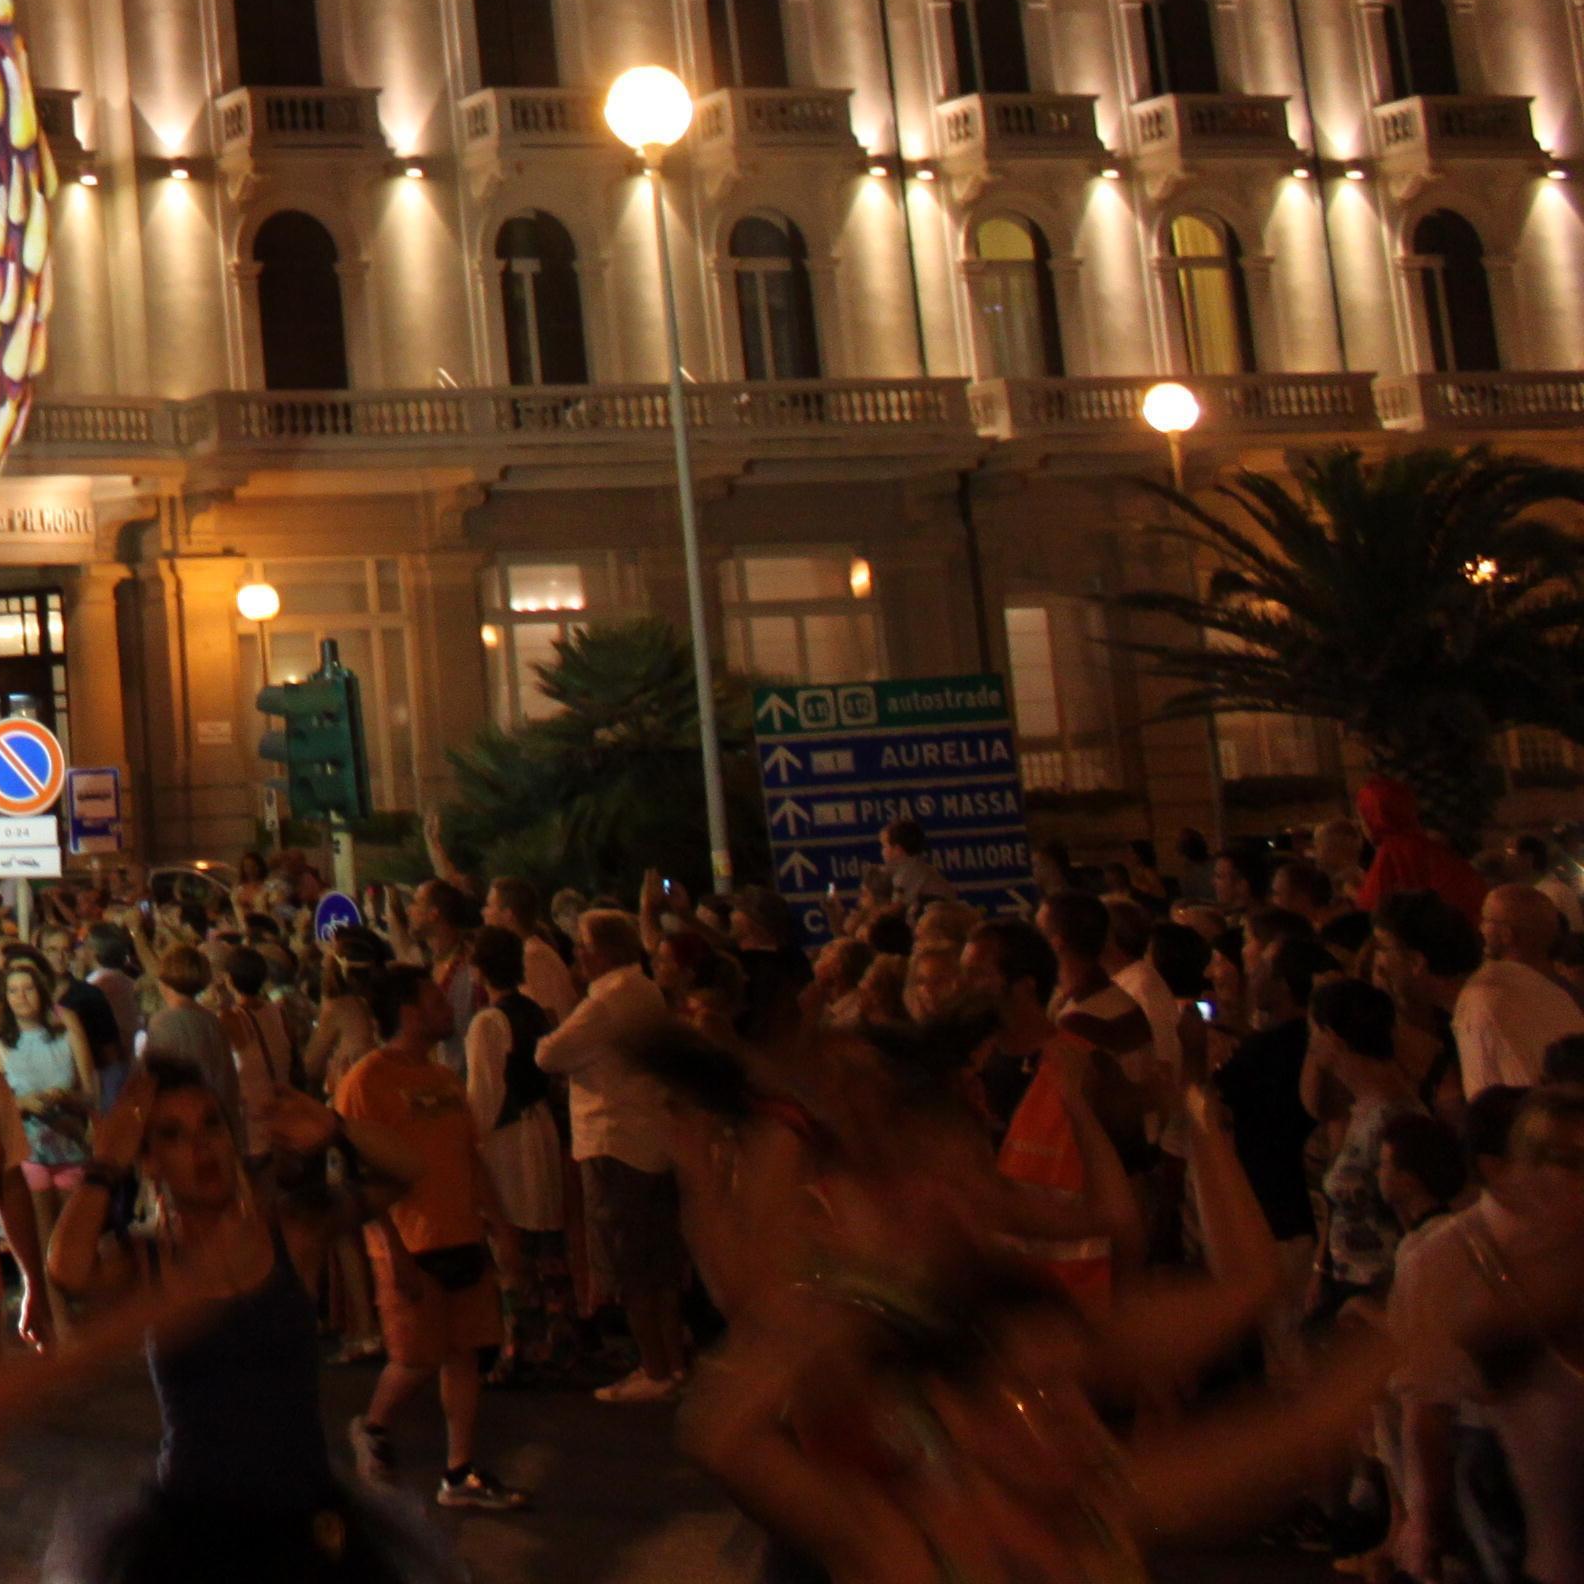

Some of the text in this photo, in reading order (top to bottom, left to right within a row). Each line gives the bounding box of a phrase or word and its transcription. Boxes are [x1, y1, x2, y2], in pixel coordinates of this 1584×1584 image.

[887, 684, 1001, 714] autostrade
[880, 737, 1010, 769] AURELIA
[860, 796, 914, 823] PISA
[942, 789, 1020, 817] MASSA
[922, 842, 1028, 872] AMAIORE
